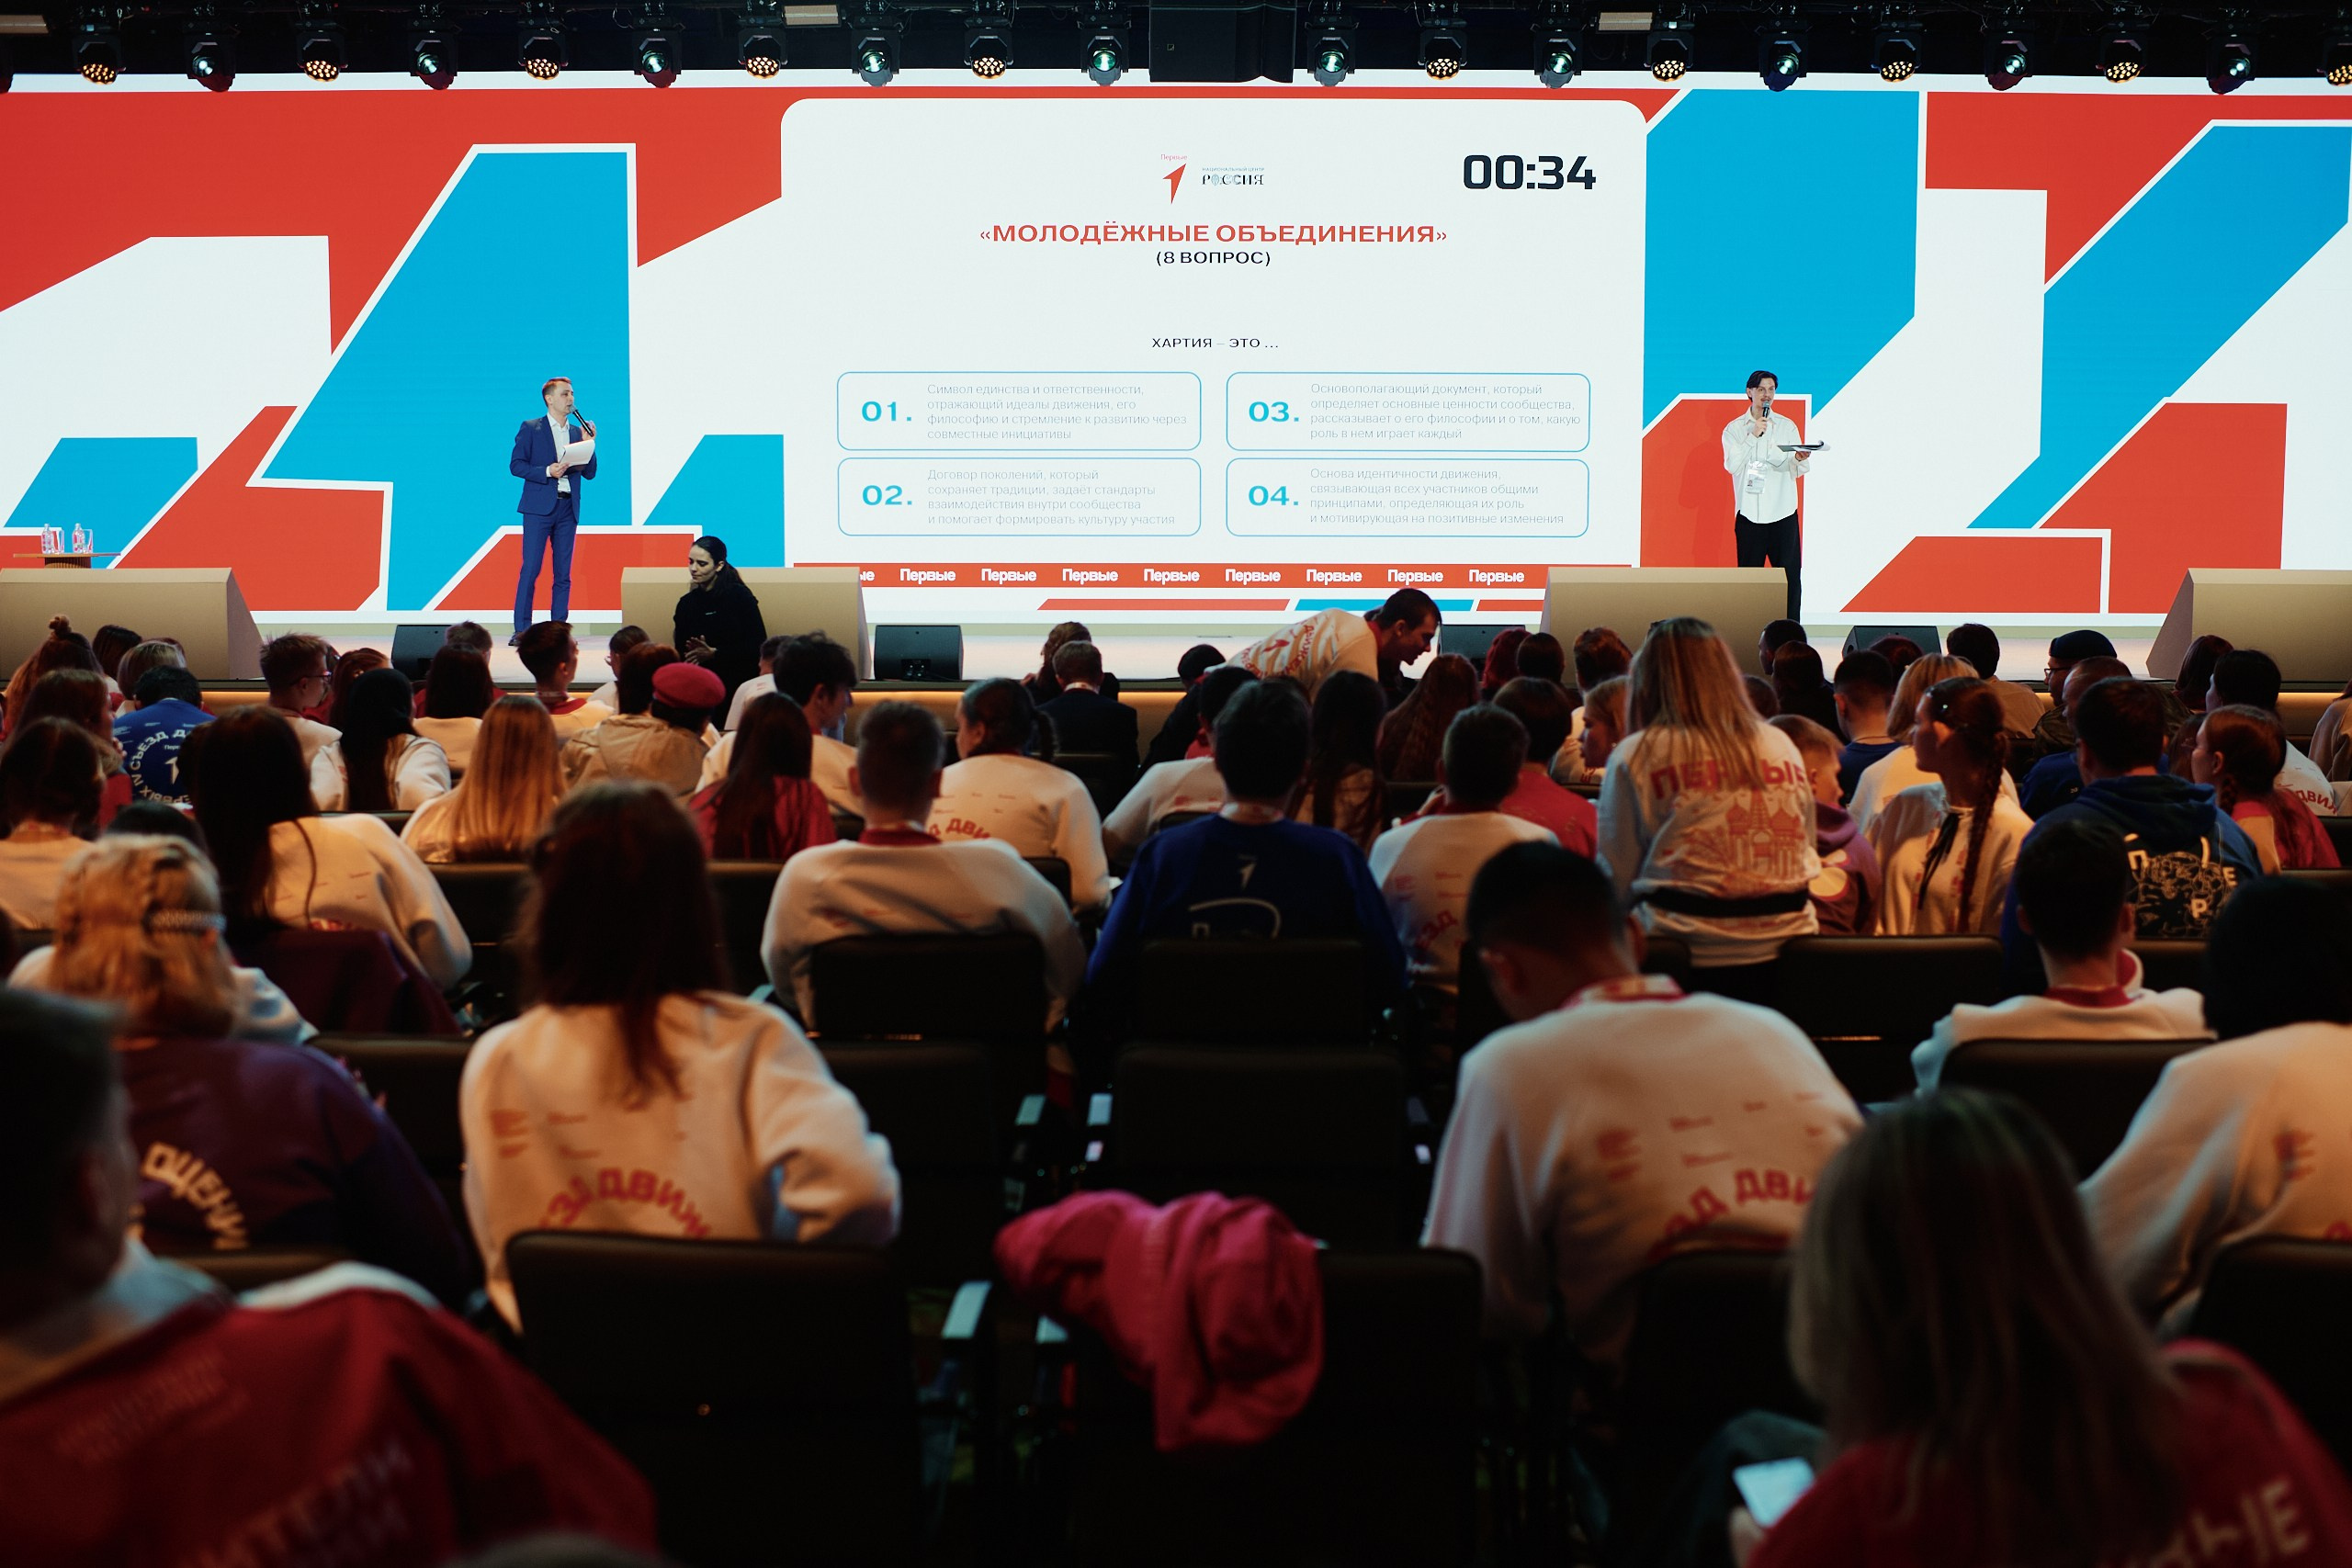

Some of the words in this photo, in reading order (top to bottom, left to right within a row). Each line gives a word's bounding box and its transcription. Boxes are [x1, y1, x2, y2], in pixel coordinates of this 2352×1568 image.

[1160, 153, 1188, 162] Первые
[1463, 154, 1597, 190] 00:34
[1202, 174, 1264, 186] РОССИЯ
[979, 220, 1210, 245] «МОЛОДЁЖНЫЕ
[1215, 224, 1448, 245] ОБЪЕДИНЕНИЯ»
[1156, 251, 1175, 266] (8
[1180, 251, 1272, 266] ВОПРОС)
[1152, 338, 1212, 348] ХАРТИЯ
[1229, 338, 1261, 348] ЭТО
[928, 385, 972, 393] Символ
[977, 386, 1029, 395] единства
[1044, 387, 1143, 395] ответственности,
[1311, 384, 1429, 395] Основополагающий
[1432, 385, 1489, 395] документ,
[1494, 383, 1543, 396] который
[861, 400, 912, 423] 01.
[928, 400, 1002, 411] отражающий
[1007, 401, 1049, 411] идеалы
[1053, 400, 1113, 411] движения,
[1117, 400, 1136, 409] его
[1249, 400, 1300, 423] 03.
[1311, 400, 1379, 410] определяет
[1443, 401, 1497, 410] ценности
[1500, 400, 1574, 411] сообщества,
[927, 413, 998, 426] философию
[1012, 416, 1081, 425] стремление
[1094, 416, 1149, 425] развитию
[1153, 416, 1186, 425] через
[1311, 415, 1391, 425] рассказывает
[1428, 413, 1495, 425] философии
[1519, 416, 1543, 424] том,
[1547, 416, 1580, 425] какую
[928, 430, 998, 438] совместные
[1002, 431, 1070, 440] инициативы
[1311, 431, 1338, 440] роль
[1376, 431, 1415, 440] играет
[1419, 428, 1461, 440] каждый
[928, 470, 977, 481] Договор
[981, 470, 1046, 480] поколений,
[1050, 470, 1098, 481] который
[1311, 468, 1353, 478] Основа
[1358, 471, 1437, 479] идентичности
[1441, 471, 1500, 479] движения,
[862, 485, 912, 506] 02.
[928, 487, 987, 496] сохраняет
[990, 487, 1048, 496] традиции,
[1053, 485, 1090, 495] задаёт
[1095, 487, 1155, 496] стандарты
[1249, 485, 1299, 507] 04.
[1311, 486, 1390, 494] связывающая
[1423, 486, 1487, 495] участников
[1491, 484, 1538, 496] общими
[929, 500, 1023, 510] взаимодействия
[1028, 502, 1066, 511] внутри
[1070, 500, 1140, 510] сообщества
[1311, 501, 1385, 509] принципами,
[1390, 501, 1477, 510] определяющая
[1498, 501, 1524, 510] роль
[996, 514, 1075, 525] формировать
[1079, 516, 1127, 525] культуру
[1131, 516, 1174, 525] участия
[1321, 515, 1408, 525] мотивирующая
[900, 568, 956, 584] Первые
[981, 568, 1037, 584] Первые
[1062, 568, 1118, 584] Первые
[1144, 569, 1200, 585] Первые
[1225, 569, 1281, 585] Первые
[1306, 569, 1363, 585] Первые
[1387, 569, 1443, 585] Первые
[1469, 569, 1525, 585] Первые
